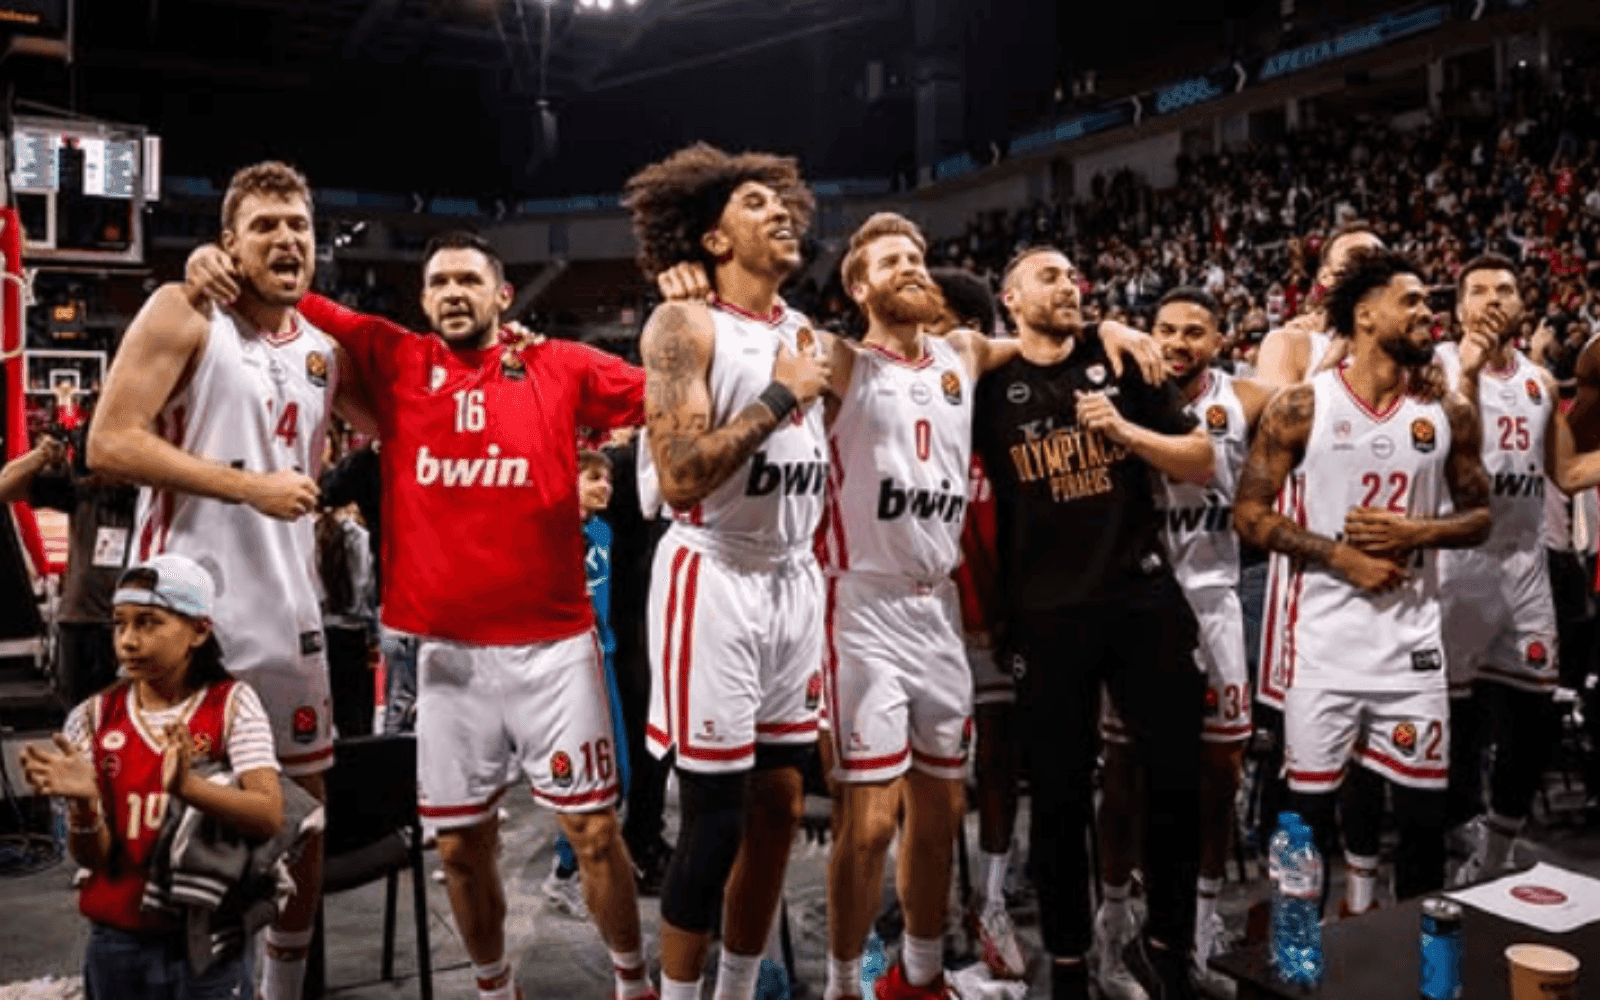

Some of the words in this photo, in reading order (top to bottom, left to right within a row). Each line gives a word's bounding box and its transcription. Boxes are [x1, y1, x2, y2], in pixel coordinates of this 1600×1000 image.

[266, 399, 298, 447] 4
[453, 389, 486, 433] 16
[915, 419, 931, 462] 0
[1497, 416, 1531, 451] 25
[416, 443, 529, 487] bwin
[745, 448, 829, 496] bwi
[1494, 463, 1544, 499] win
[1361, 471, 1408, 513] 22
[580, 738, 613, 781] 16
